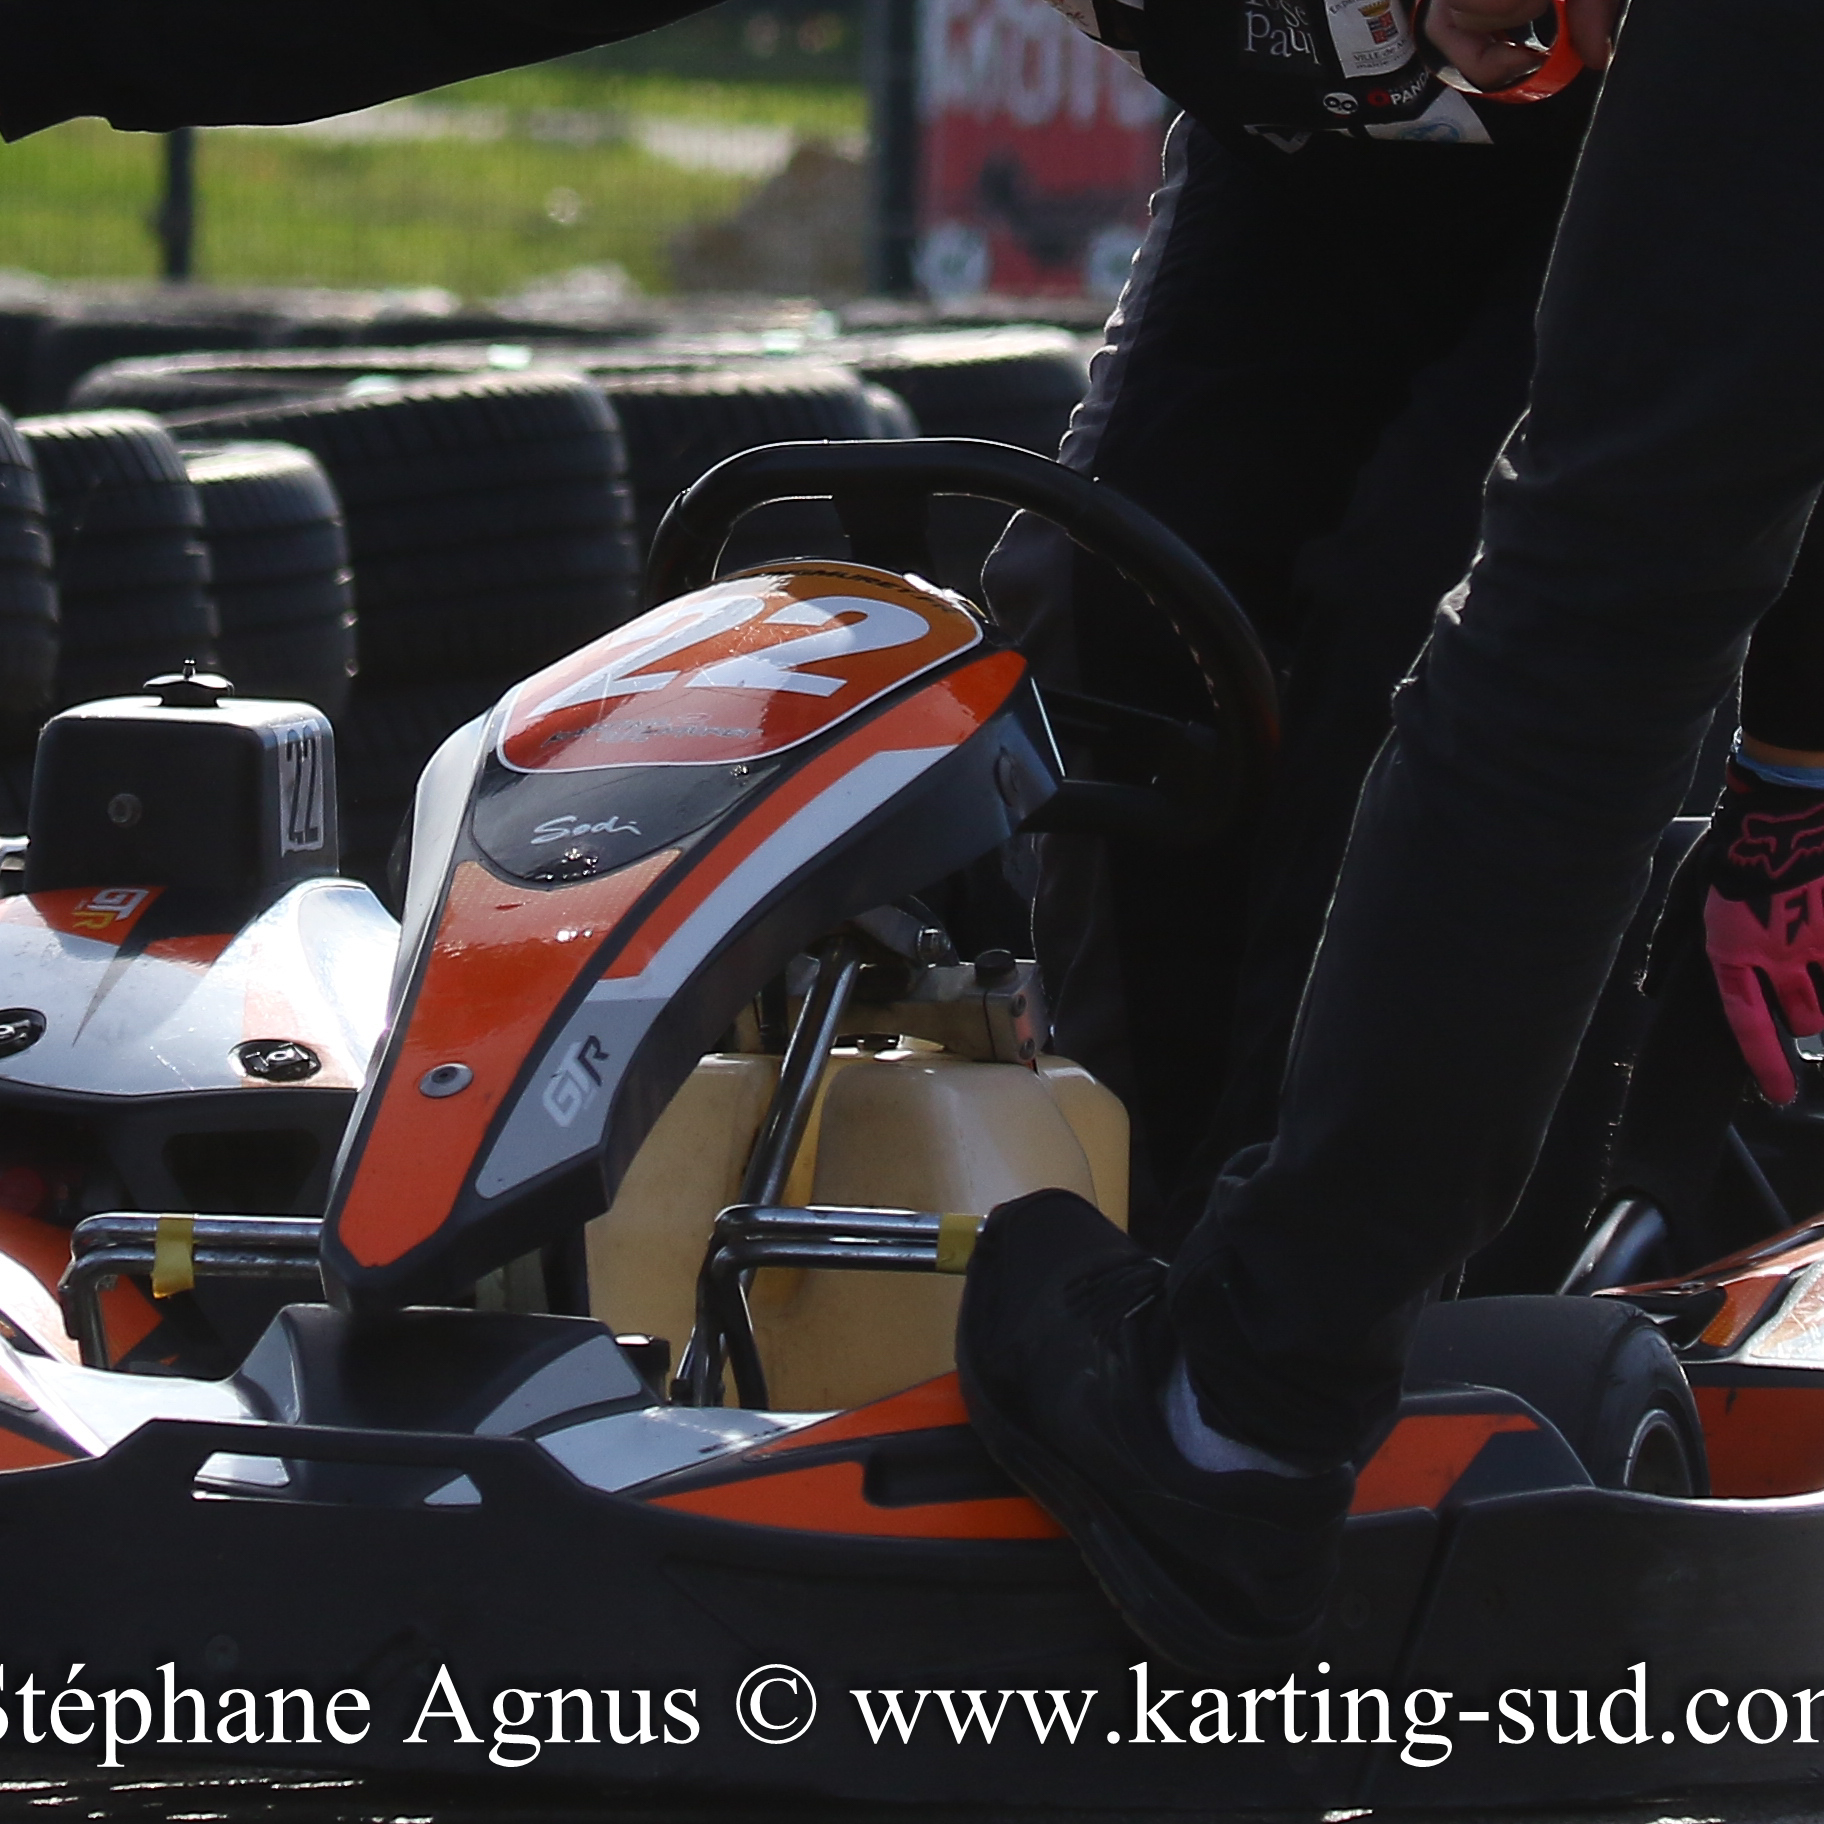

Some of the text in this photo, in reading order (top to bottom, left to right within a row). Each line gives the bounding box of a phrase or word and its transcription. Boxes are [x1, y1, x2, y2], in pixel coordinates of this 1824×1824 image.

[1244, 9, 1321, 66] Paul
[527, 595, 930, 719] 22
[285, 725, 321, 845] 22
[531, 815, 640, 846] Sodi
